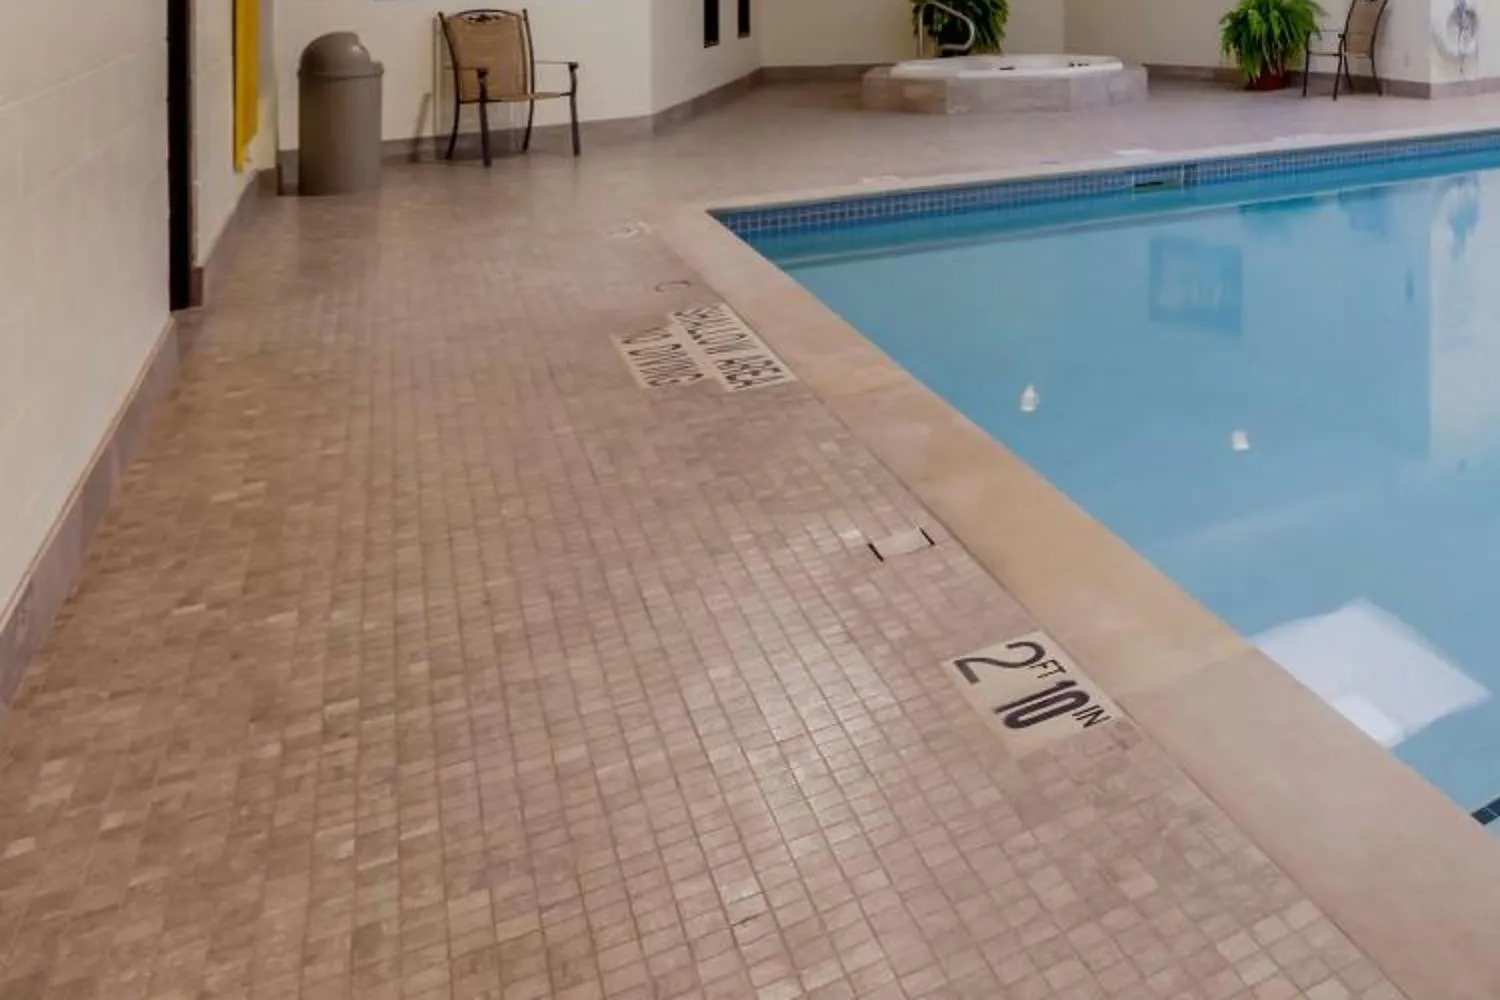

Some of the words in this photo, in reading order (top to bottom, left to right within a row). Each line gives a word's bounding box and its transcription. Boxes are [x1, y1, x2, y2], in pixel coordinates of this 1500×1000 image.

[715, 354, 787, 392] AREA
[952, 640, 1046, 685] 2
[1029, 658, 1068, 680] FT
[992, 679, 1091, 730] 10
[1070, 704, 1113, 729] IN
